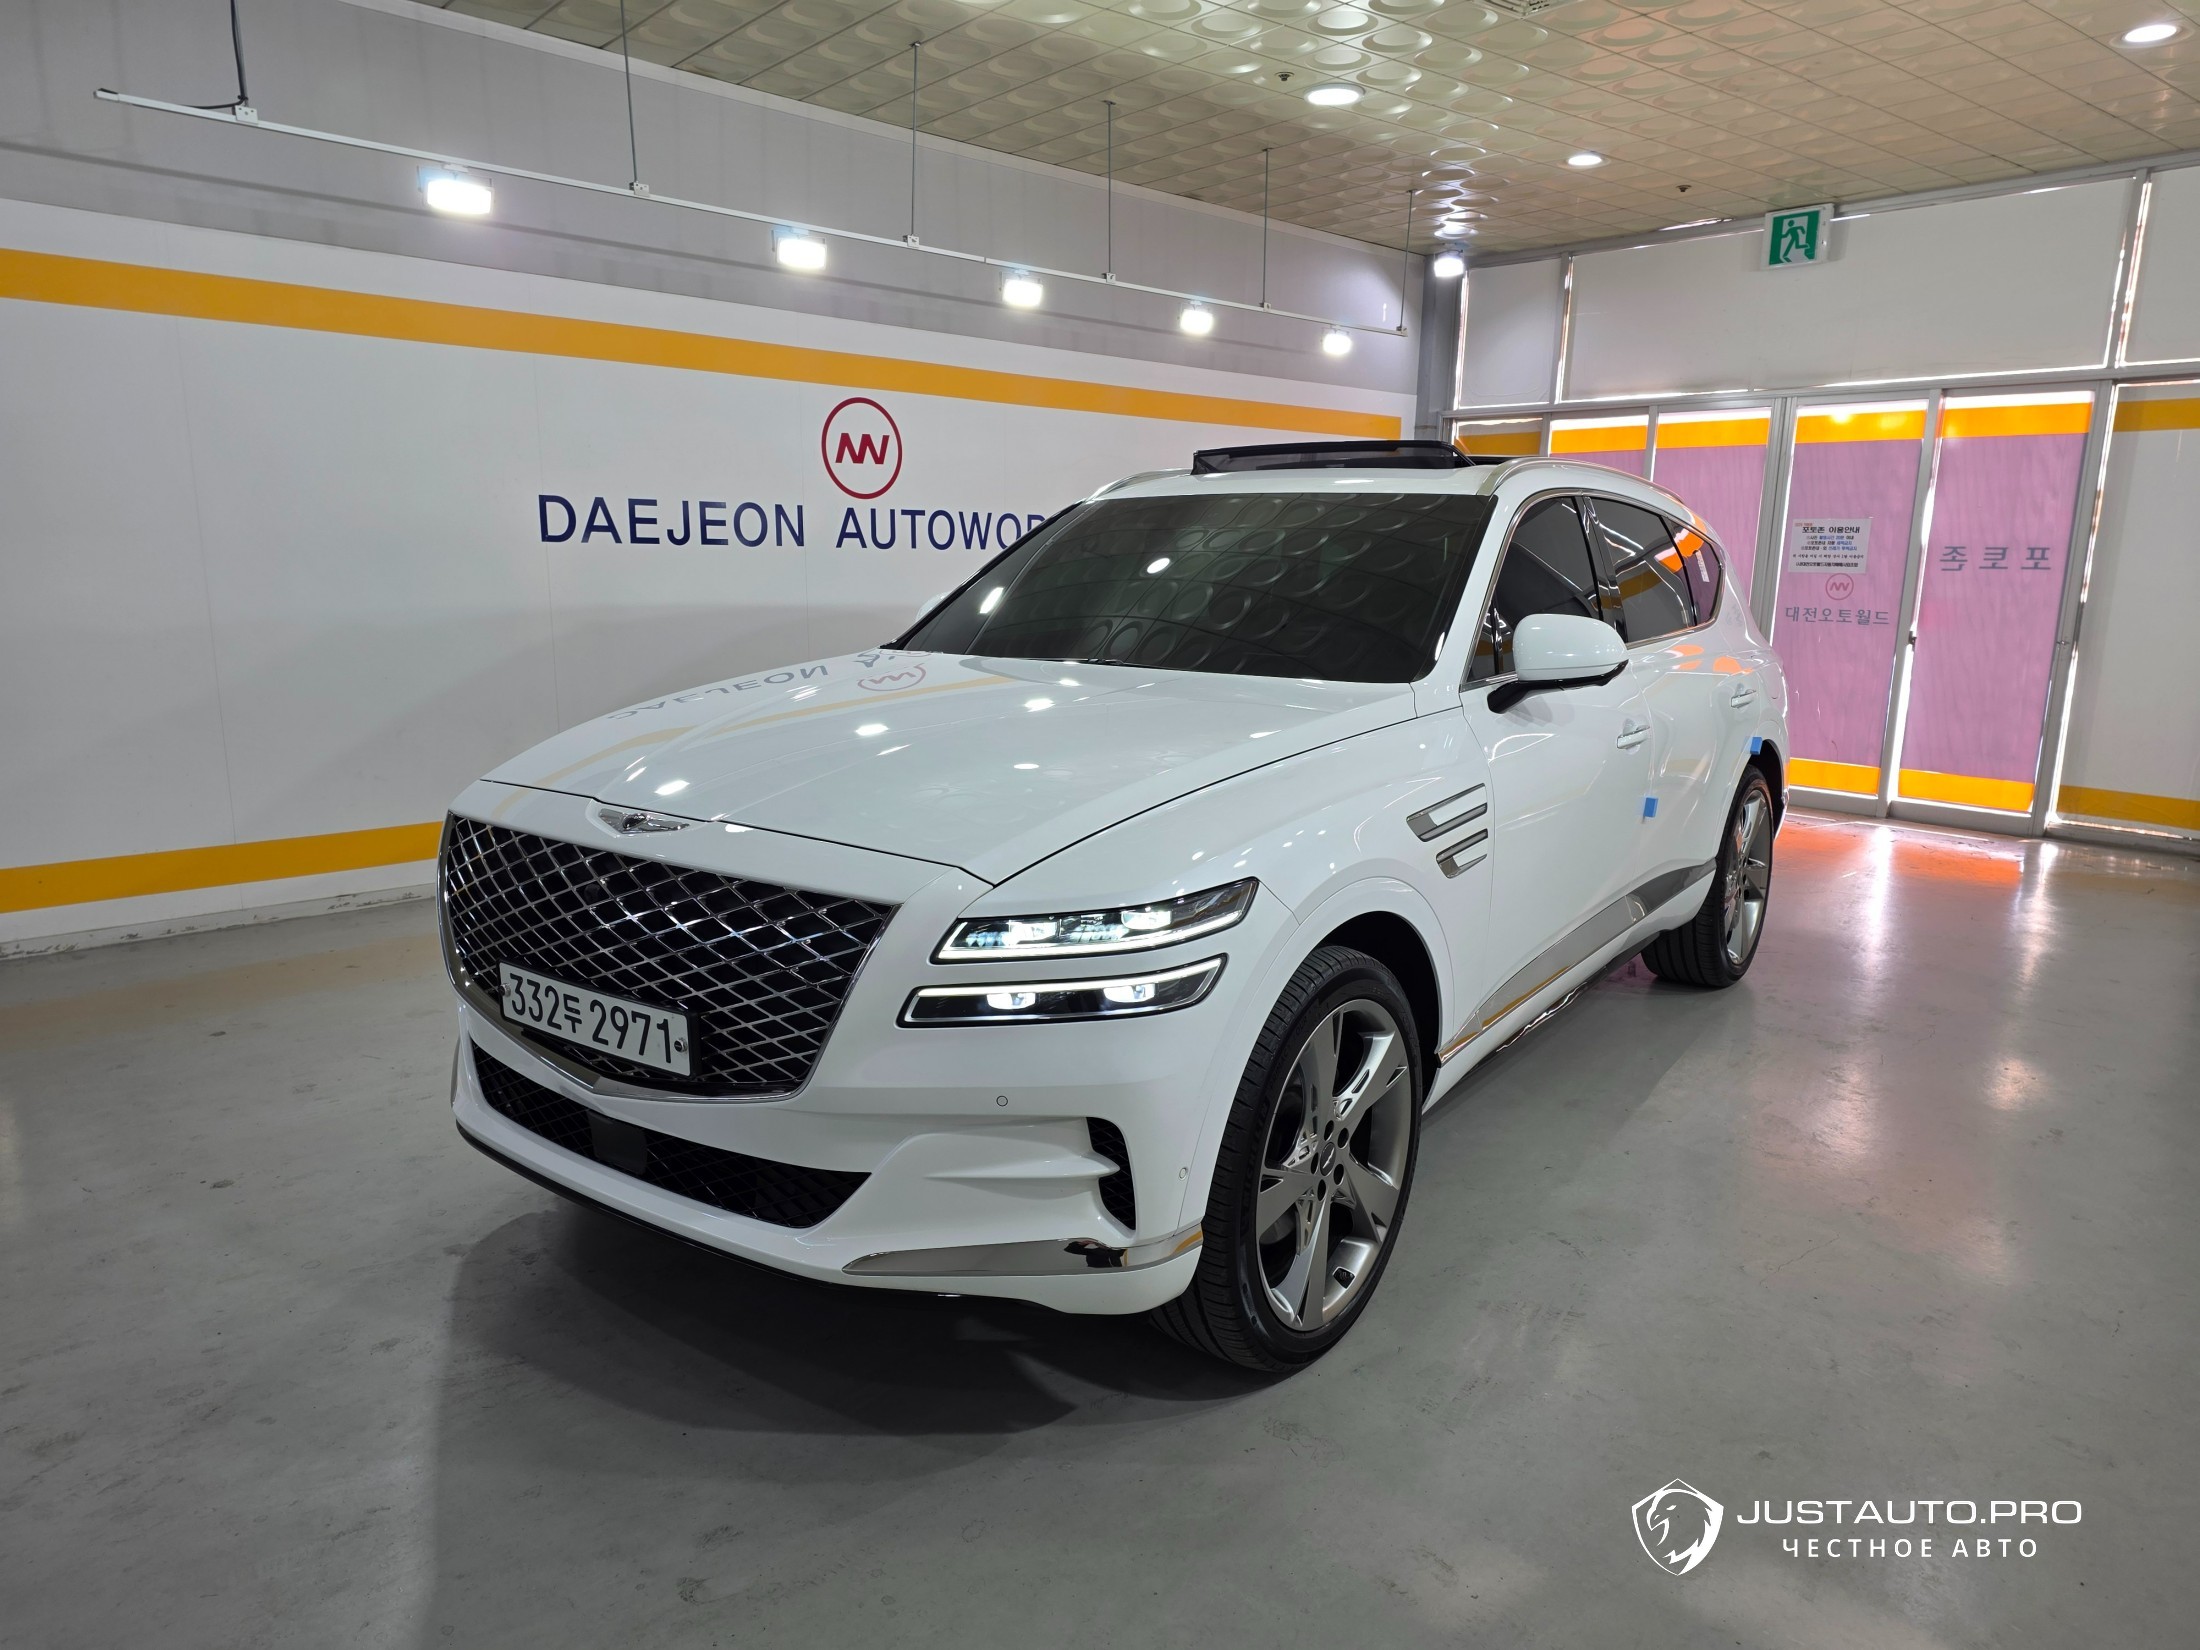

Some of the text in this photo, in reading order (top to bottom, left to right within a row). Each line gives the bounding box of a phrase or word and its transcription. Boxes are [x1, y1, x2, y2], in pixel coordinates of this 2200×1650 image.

[538, 494, 805, 547] DAEJEON
[1802, 526, 1860, 534] 포토존 이용안내
[1785, 607, 1890, 625] 대전오토월드
[509, 973, 672, 1064] 332두 2971
